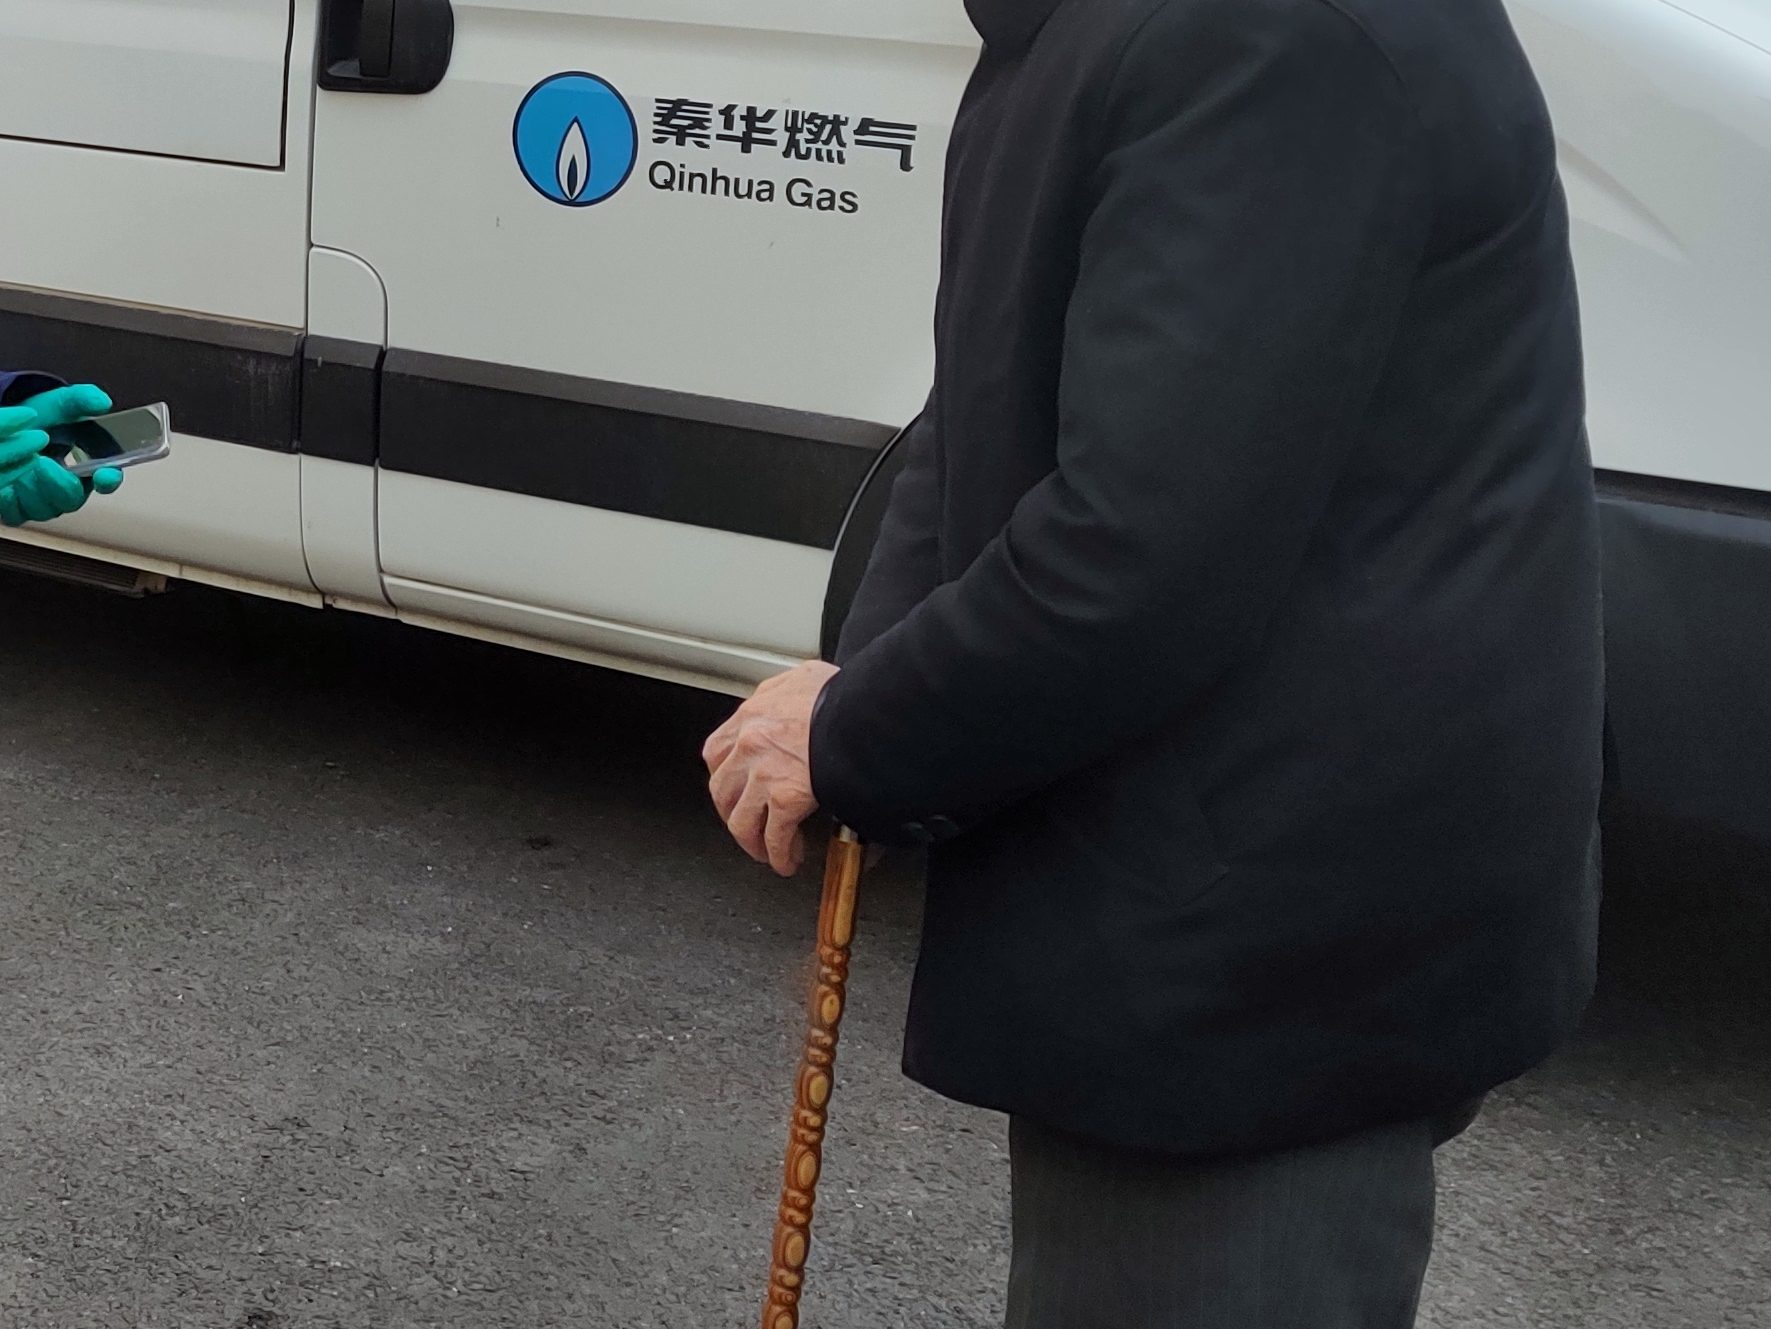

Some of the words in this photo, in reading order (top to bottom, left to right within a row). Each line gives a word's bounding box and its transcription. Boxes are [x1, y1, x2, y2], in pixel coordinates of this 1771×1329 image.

[651, 97, 918, 173] 秦华燃气
[648, 160, 775, 203] Qinhua
[785, 177, 860, 214] Gas
